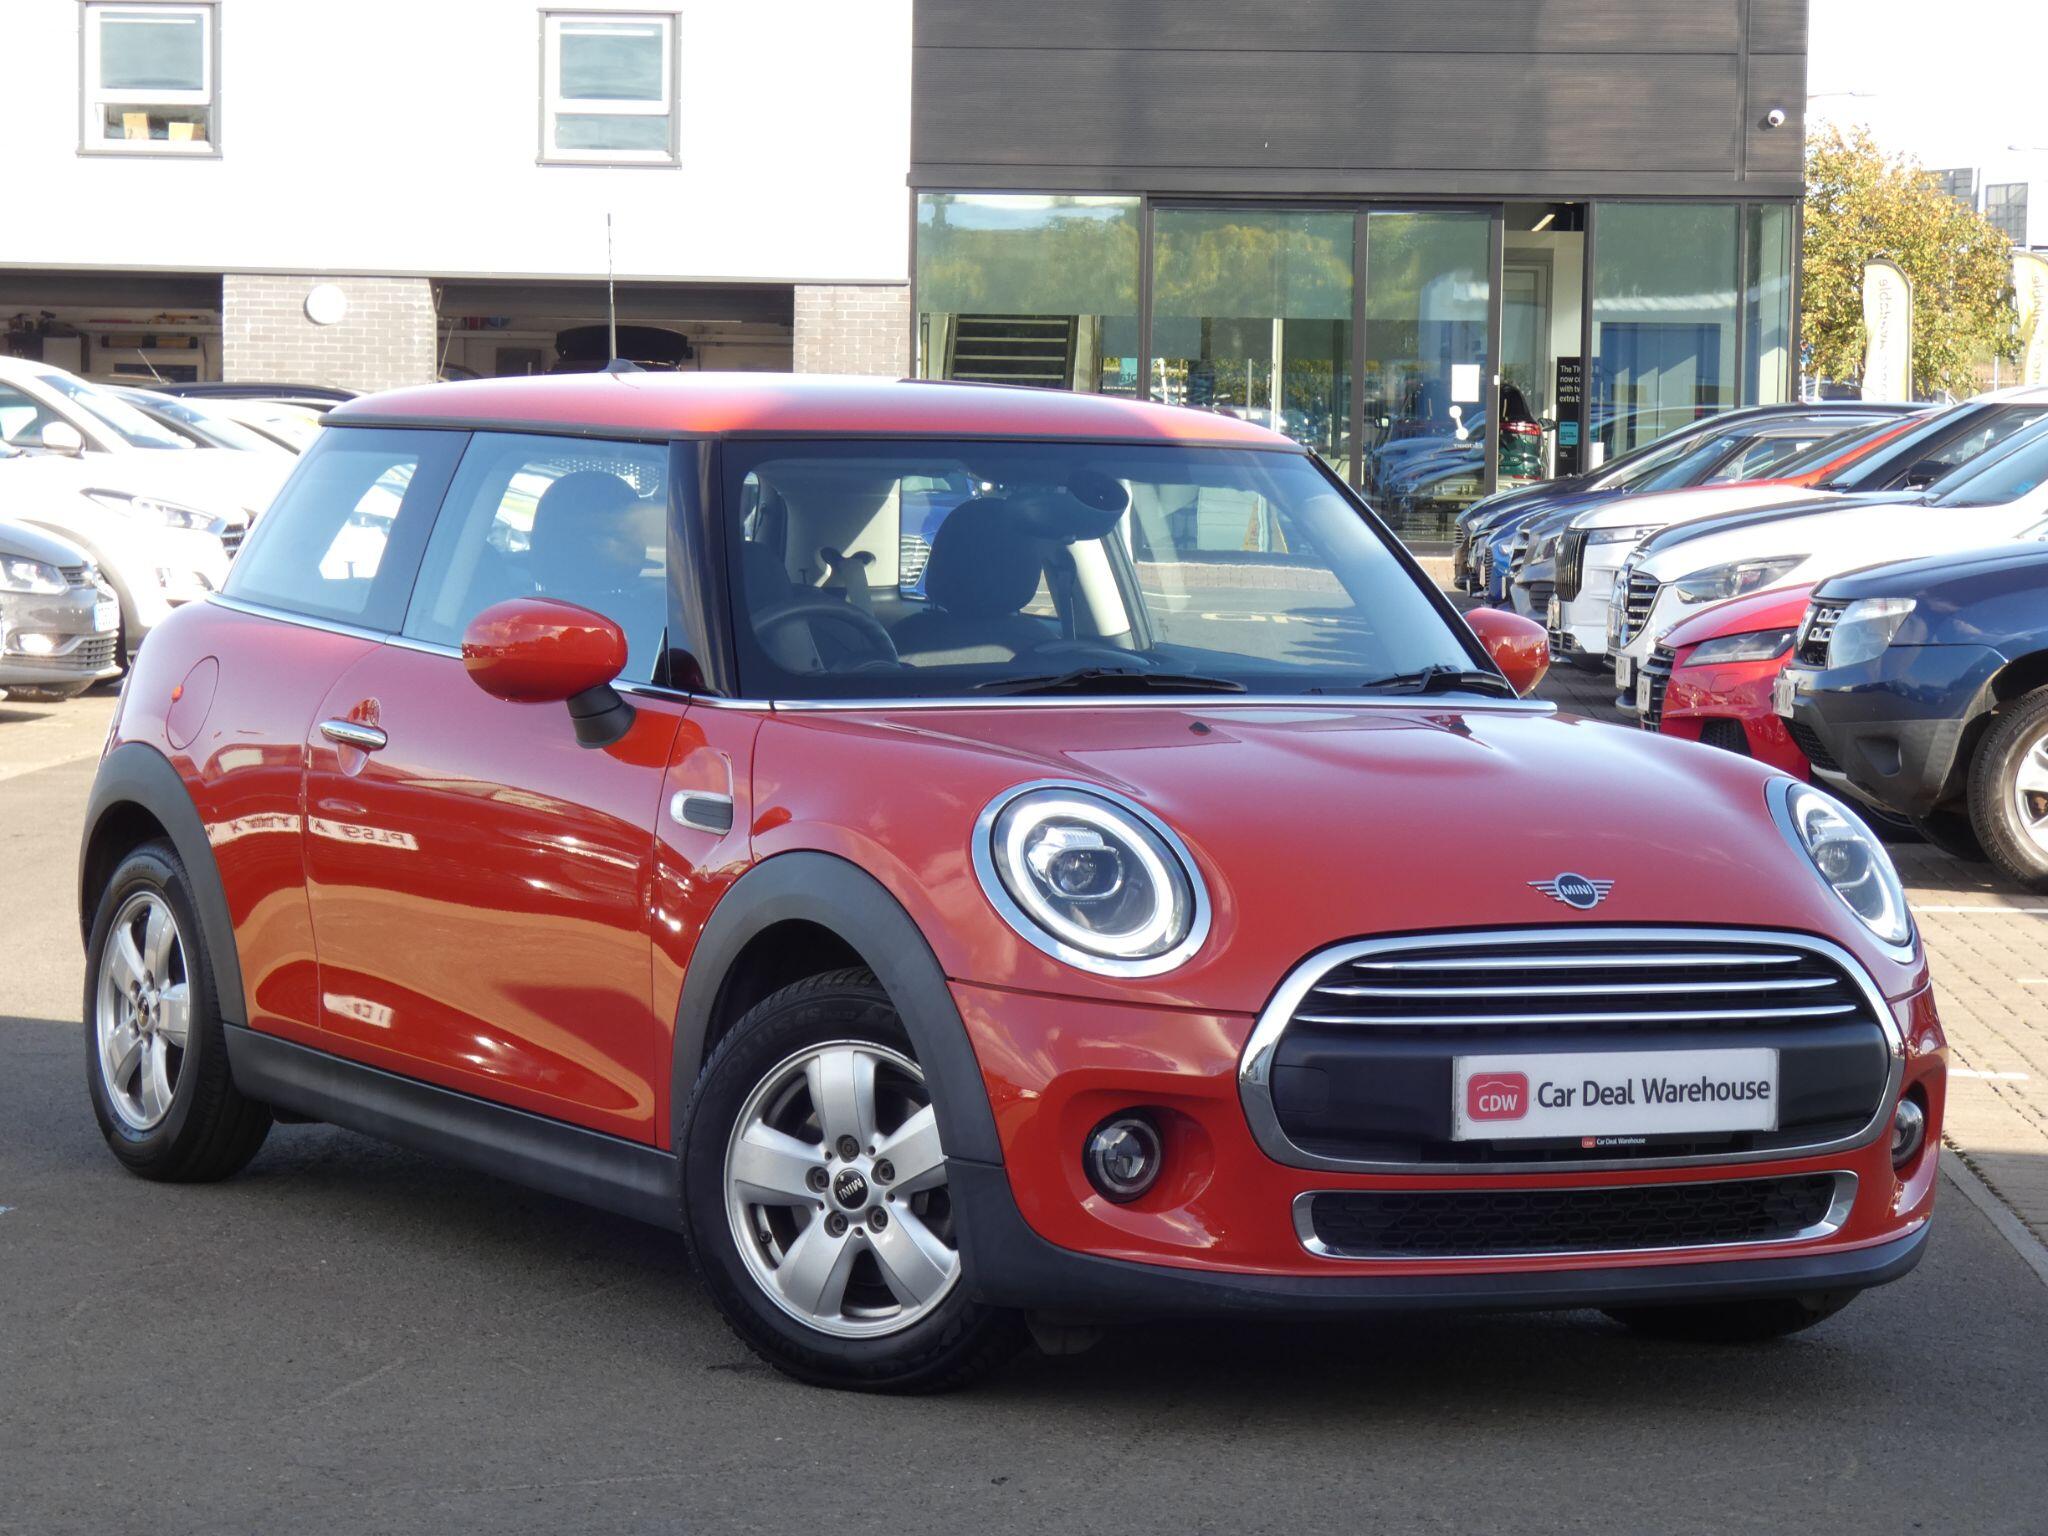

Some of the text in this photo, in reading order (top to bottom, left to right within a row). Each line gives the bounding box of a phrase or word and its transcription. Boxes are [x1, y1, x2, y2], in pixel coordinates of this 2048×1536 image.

[1560, 365, 1572, 373] The
[1559, 395, 1575, 403] extra
[1560, 884, 1593, 895] MINI
[1537, 1076, 1771, 1108] Car Deal Warehouse
[1478, 1094, 1518, 1112] CDW
[1618, 1137, 1646, 1145] Warehouse
[838, 1177, 864, 1201] MINI
